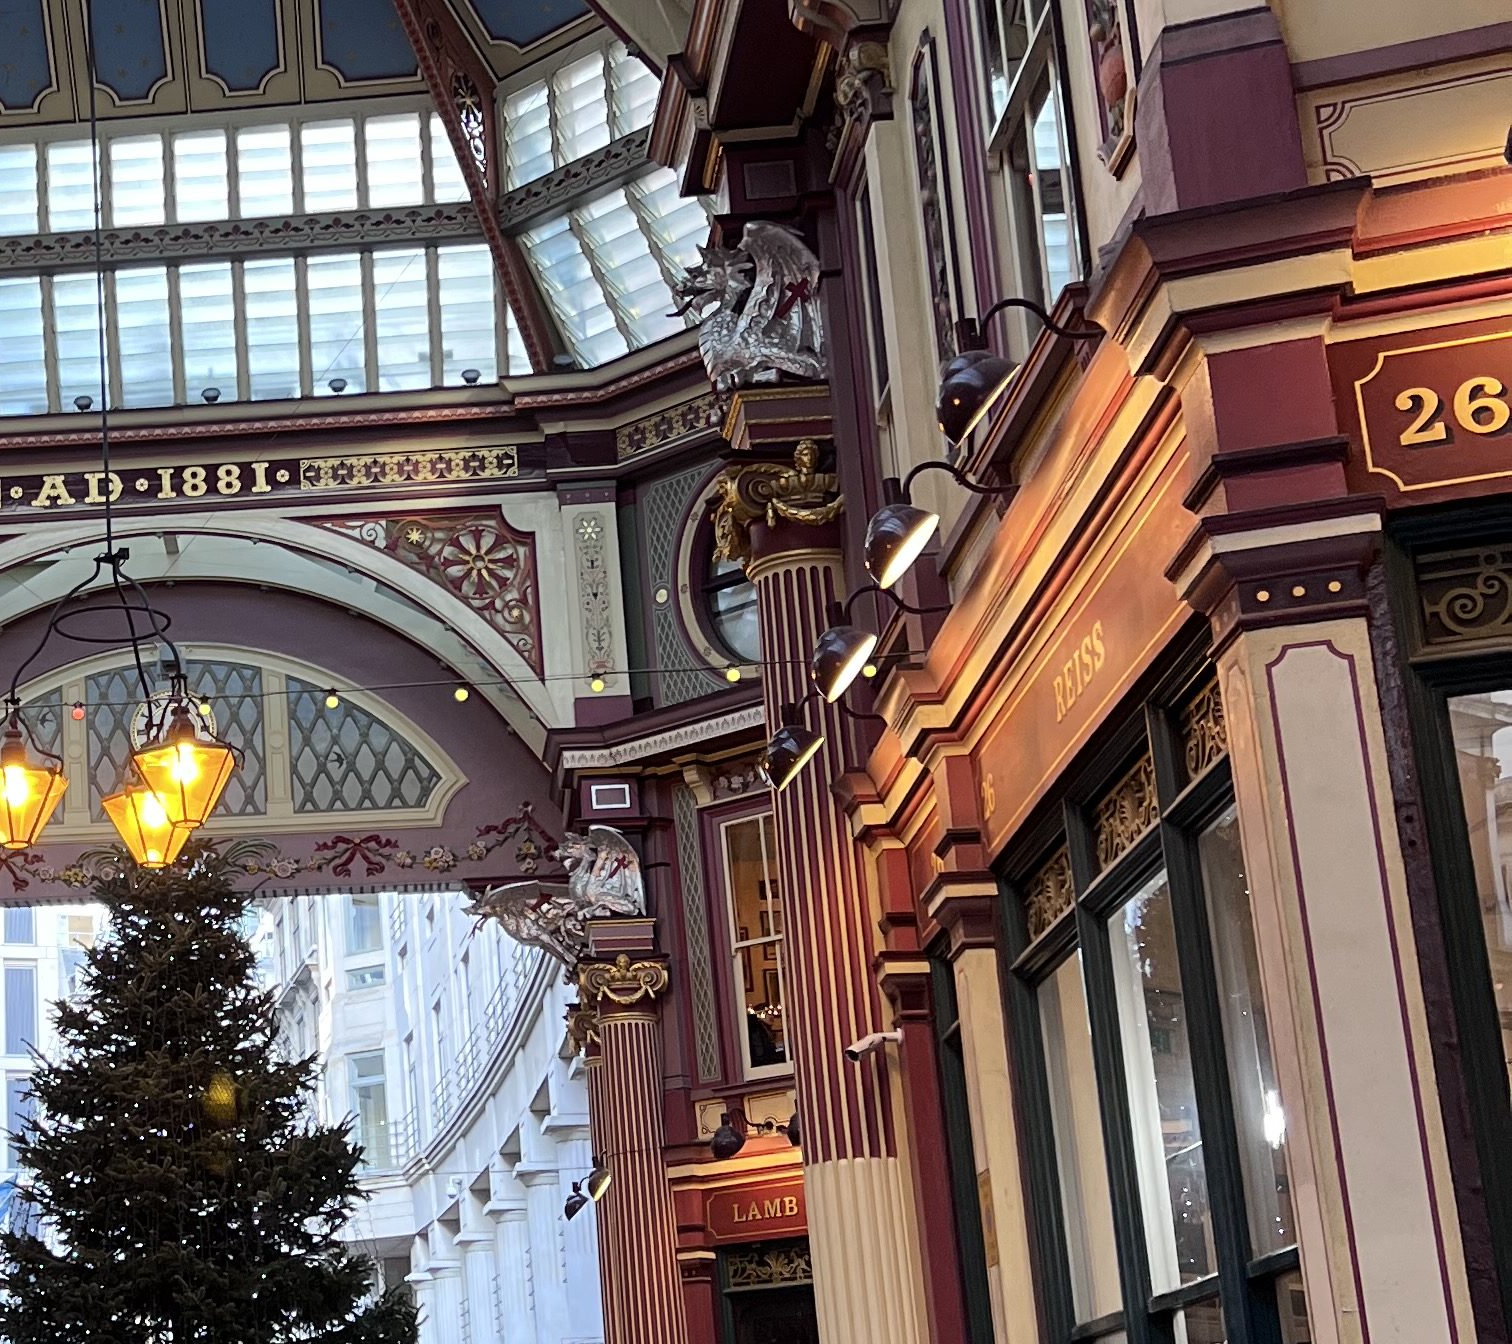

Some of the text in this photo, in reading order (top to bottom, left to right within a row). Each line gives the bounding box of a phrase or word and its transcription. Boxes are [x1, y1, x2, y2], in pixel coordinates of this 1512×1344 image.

[1395, 376, 1510, 446] 26
[157, 462, 272, 499] 1881
[1053, 620, 1105, 724] REISS
[733, 1196, 799, 1223] LAMB
